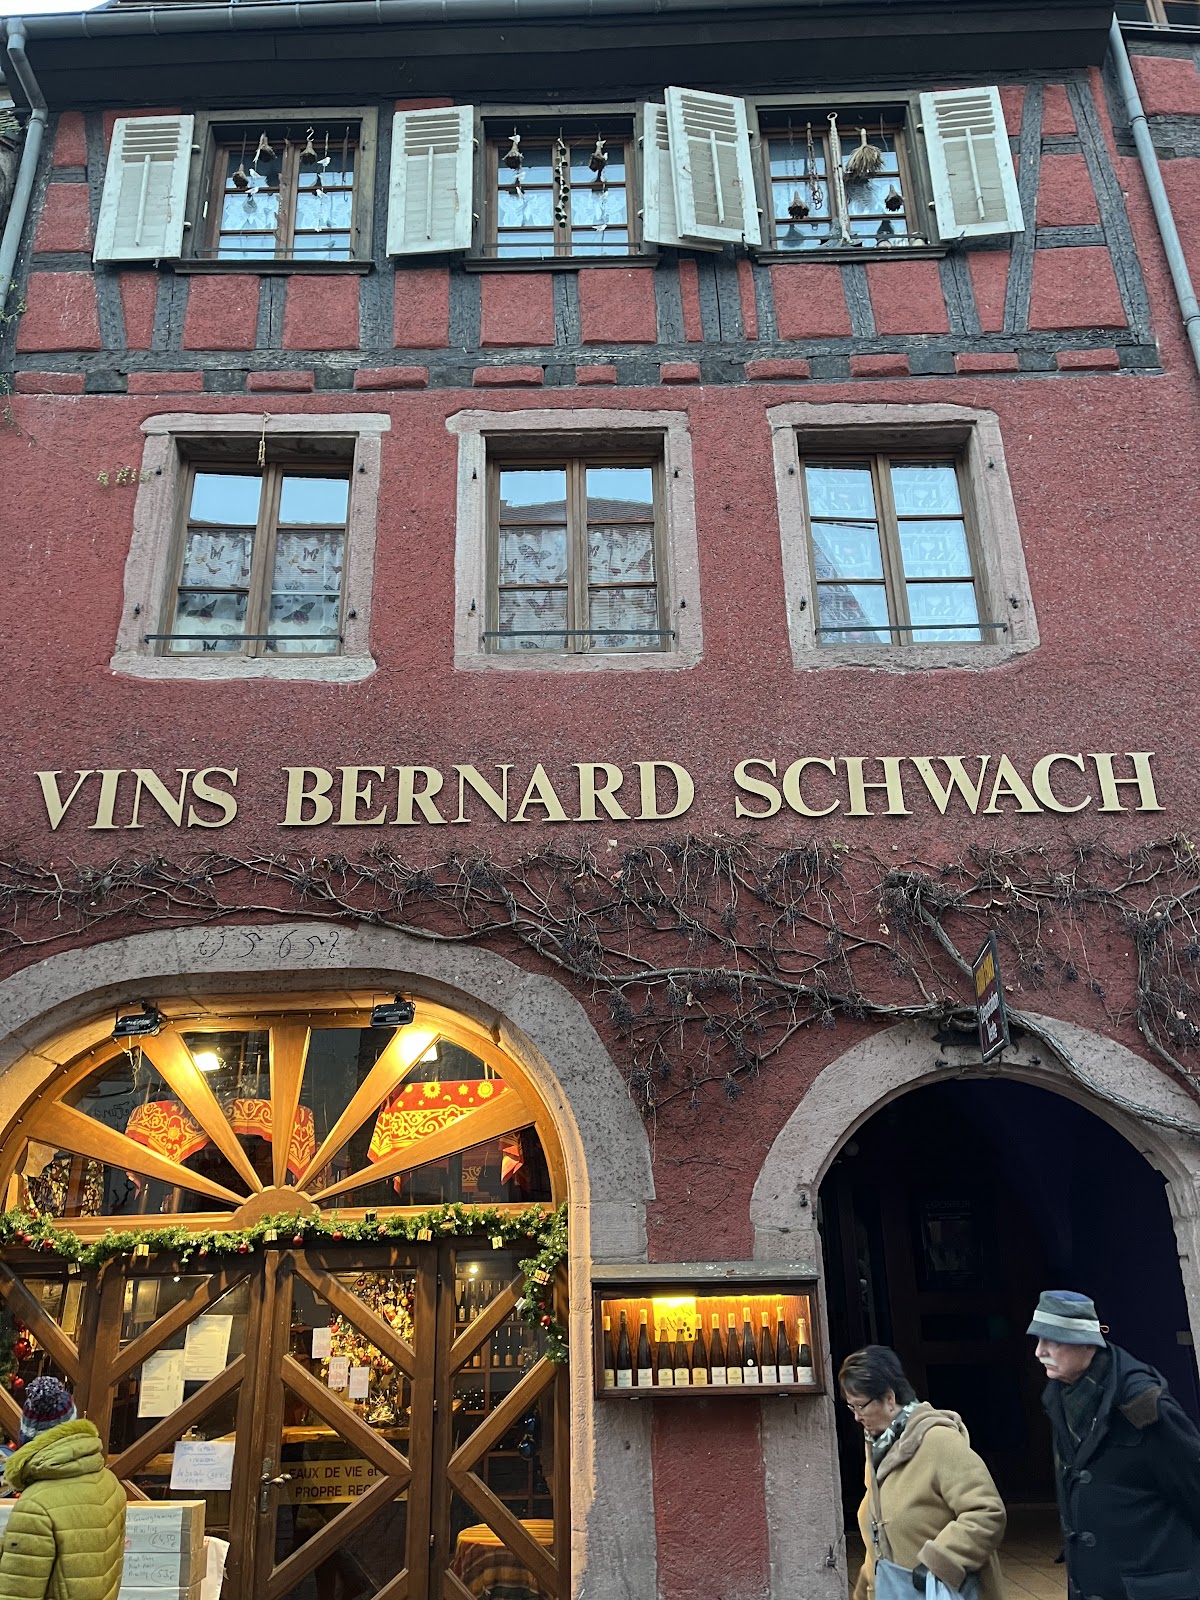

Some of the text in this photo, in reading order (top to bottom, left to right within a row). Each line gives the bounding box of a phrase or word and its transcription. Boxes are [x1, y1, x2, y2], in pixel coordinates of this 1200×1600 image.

[34, 751, 1167, 831] VINS BERNARD SCHWACH
[289, 1467, 319, 1479] EAUX
[325, 1466, 341, 1478] DE
[345, 1465, 363, 1477] VIE
[295, 1485, 342, 1498] PROPRE
